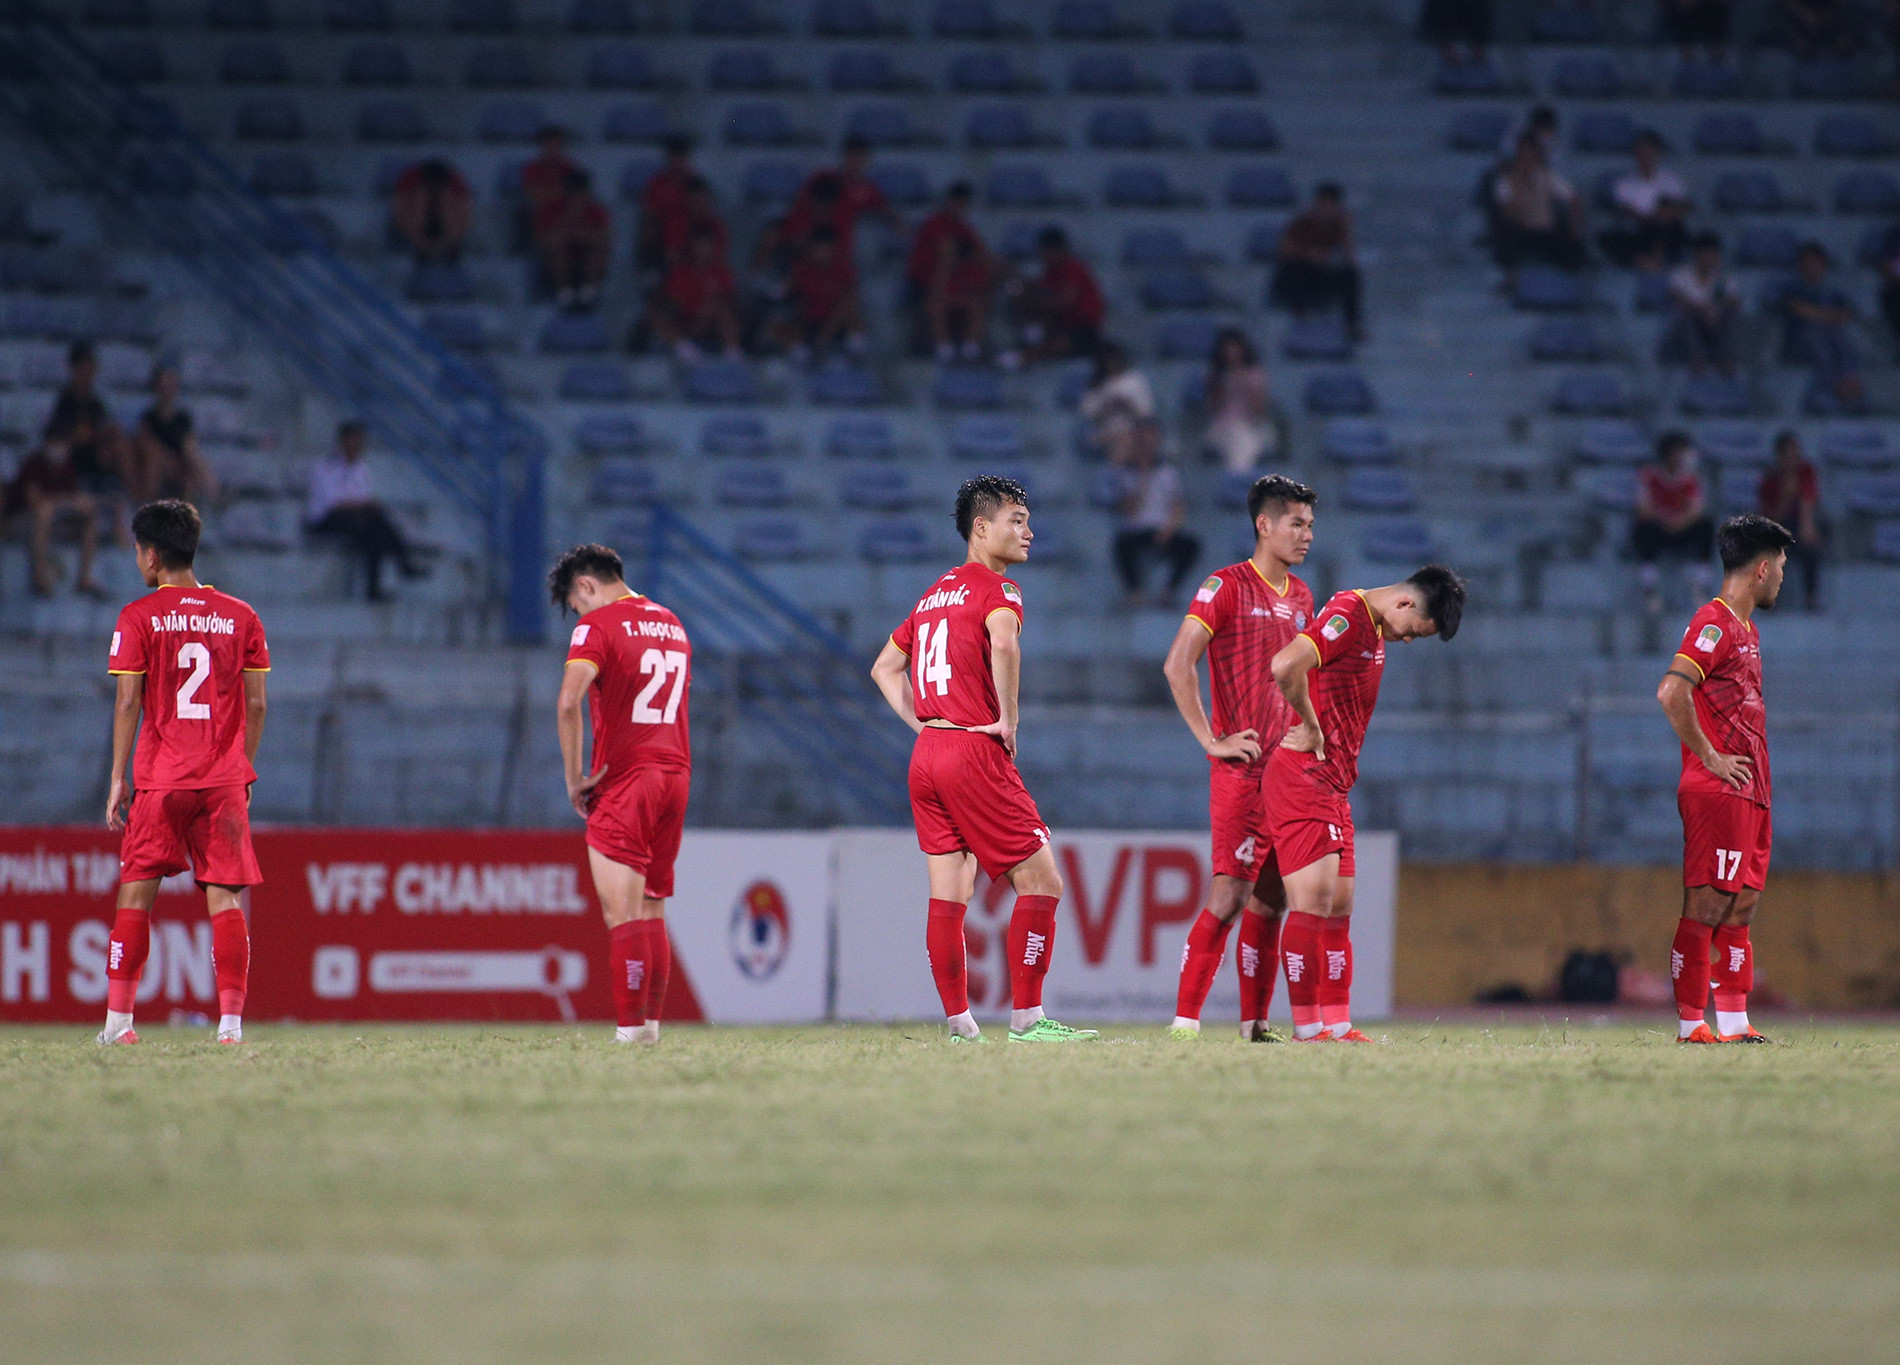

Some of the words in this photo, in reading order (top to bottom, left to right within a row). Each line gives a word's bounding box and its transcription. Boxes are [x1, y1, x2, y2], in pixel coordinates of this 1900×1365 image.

[917, 618, 952, 700] 14
[177, 642, 211, 719] 2
[631, 648, 688, 724] 27
[1234, 836, 1256, 866] 4
[1716, 848, 1743, 881] 17
[306, 862, 388, 914] VFF
[393, 862, 588, 915] CHANNEL
[1058, 844, 1203, 967] VP
[110, 940, 124, 970] Mitre
[1023, 931, 1046, 966] Mitre
[1241, 942, 1260, 978] Mitre
[1671, 949, 1685, 980] Mitre
[1728, 945, 1747, 973] Mitre
[625, 959, 645, 990] Mitre
[1286, 951, 1306, 983] Mitre
[1326, 950, 1347, 981] Mitre
